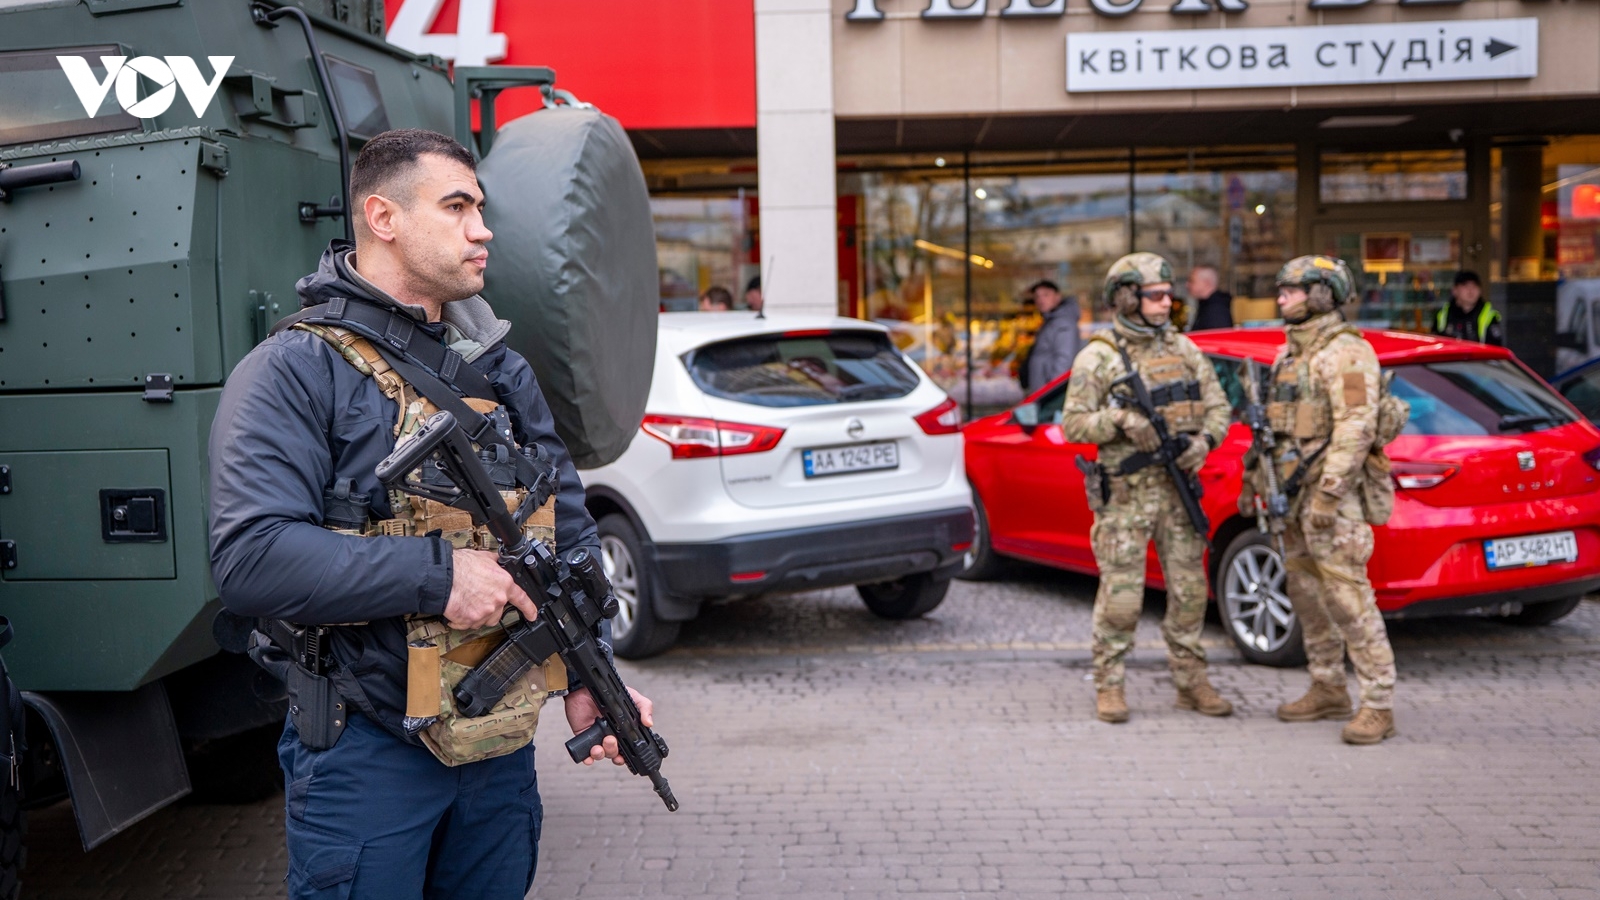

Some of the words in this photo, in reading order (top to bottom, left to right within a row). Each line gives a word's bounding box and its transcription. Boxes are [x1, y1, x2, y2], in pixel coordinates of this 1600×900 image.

[1080, 38, 1290, 74] квіткова
[1315, 28, 1473, 76] студія
[815, 451, 836, 471] AA
[839, 447, 871, 467] 1242
[873, 444, 894, 464] PE
[1496, 541, 1517, 561] AP
[1519, 536, 1553, 559] 5482
[1553, 535, 1573, 555] HT
